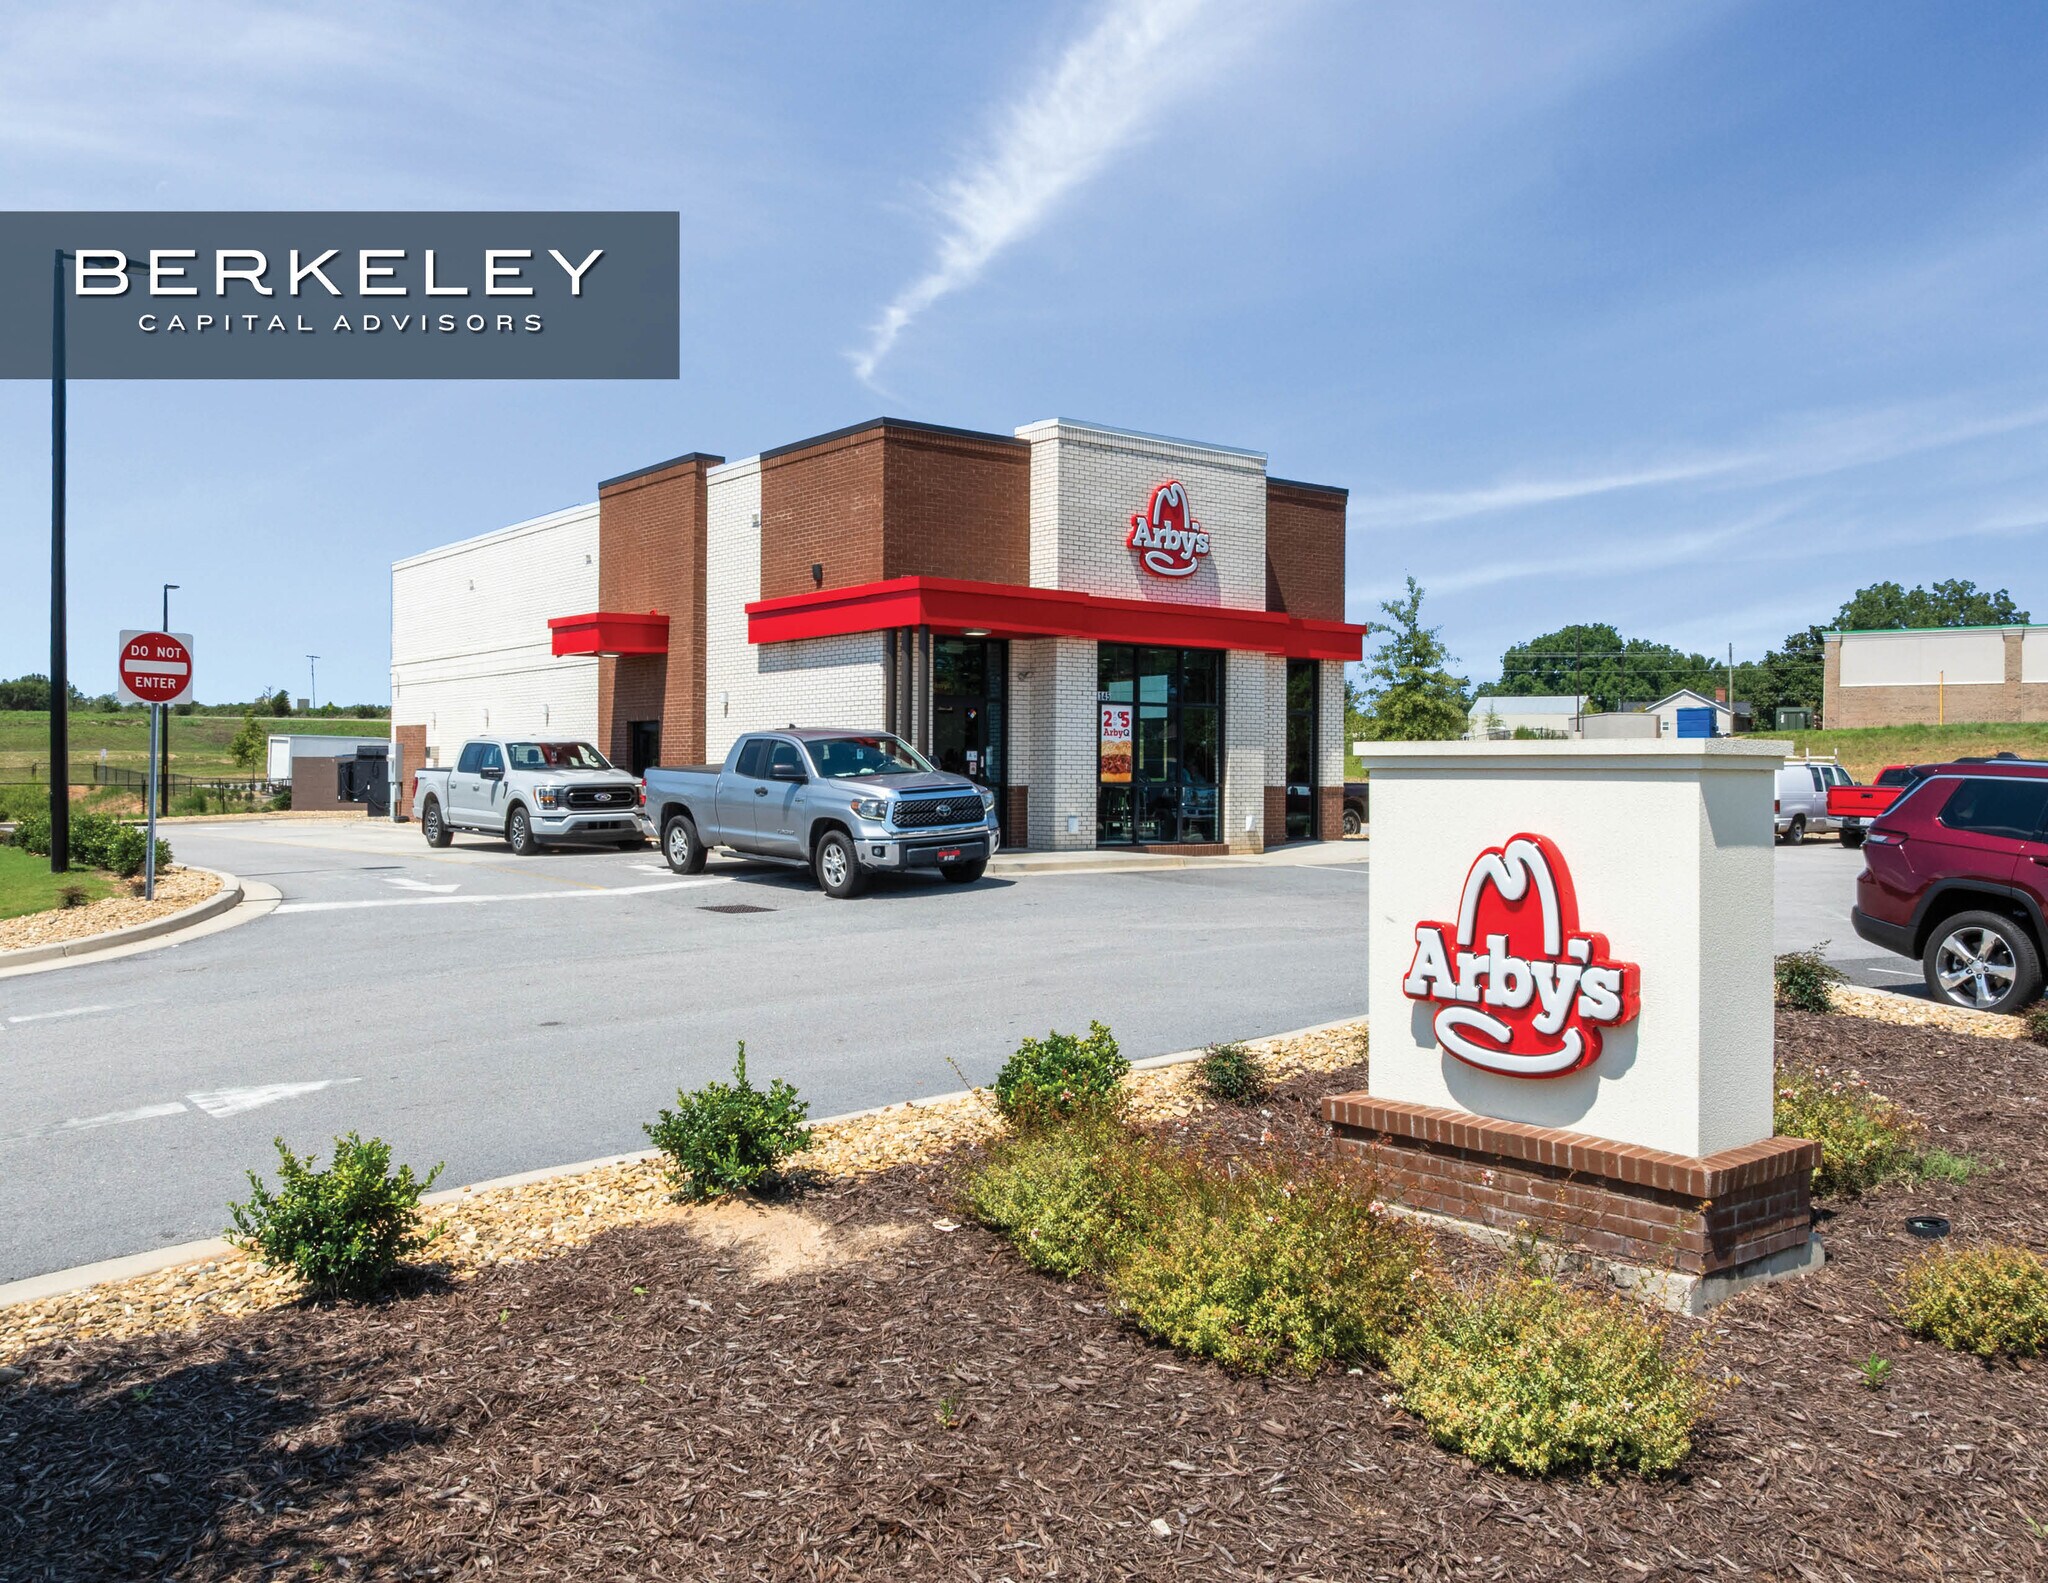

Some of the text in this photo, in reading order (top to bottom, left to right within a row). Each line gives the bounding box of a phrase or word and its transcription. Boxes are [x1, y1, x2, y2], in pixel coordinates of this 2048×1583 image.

[1132, 517, 1209, 560] Arby's
[131, 645, 182, 659] DO NOT
[135, 676, 176, 690] ENTER
[1103, 710, 1112, 727] 2
[1404, 926, 1624, 1035] Arby's
